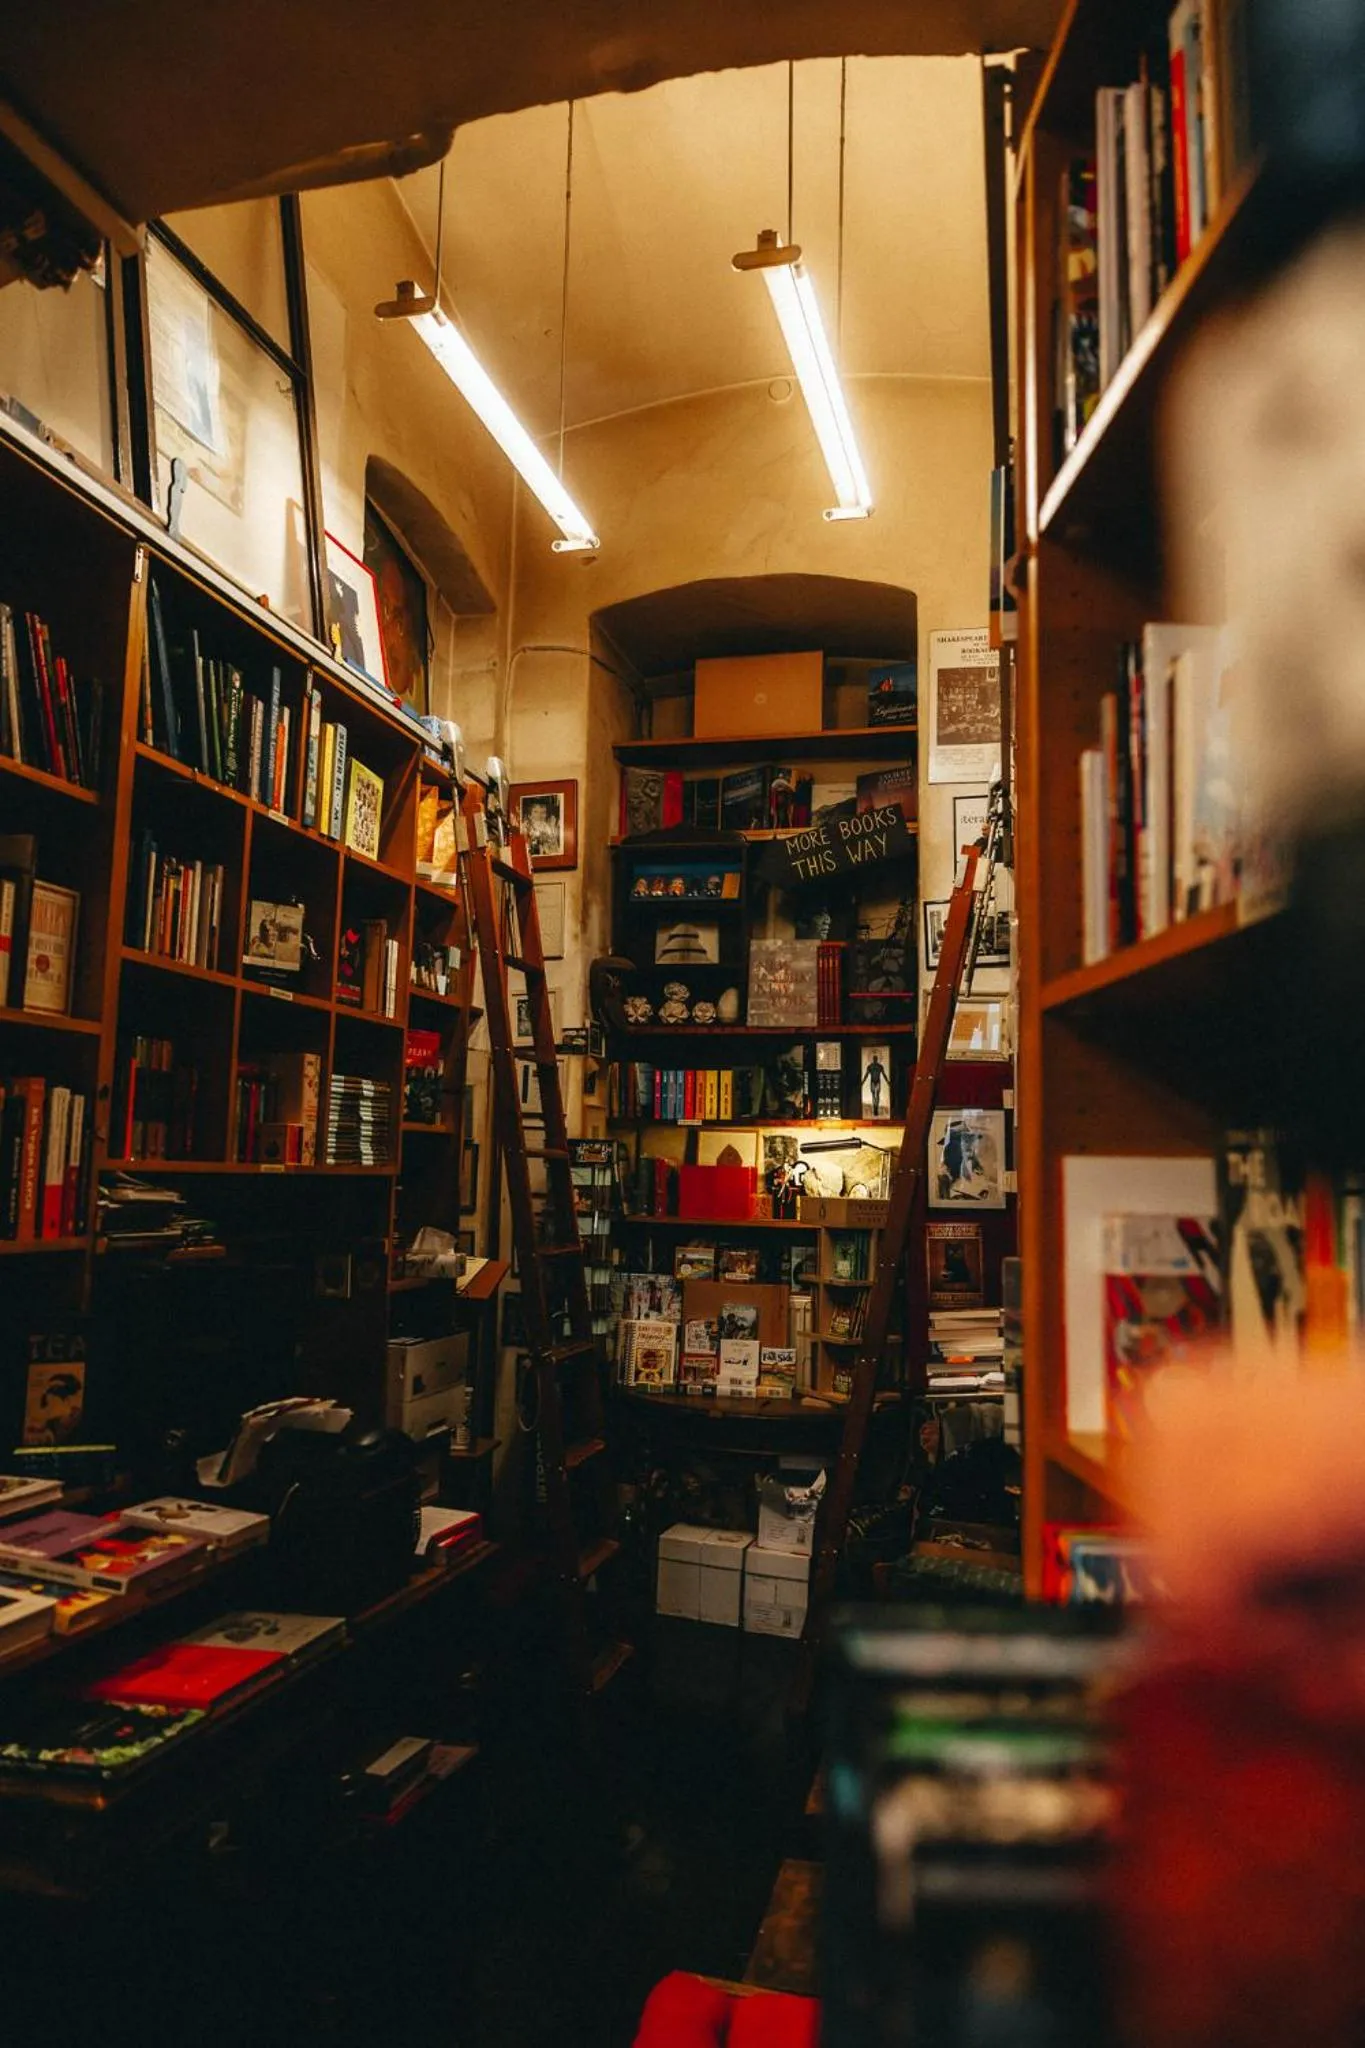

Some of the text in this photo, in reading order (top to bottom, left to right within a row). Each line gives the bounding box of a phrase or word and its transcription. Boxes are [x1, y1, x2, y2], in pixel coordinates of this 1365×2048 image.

[336, 733, 345, 775] SUPER
[785, 807, 898, 857] MORE BOOKS
[791, 833, 889, 879] THIS WAY
[28, 1333, 87, 1360] TEA
